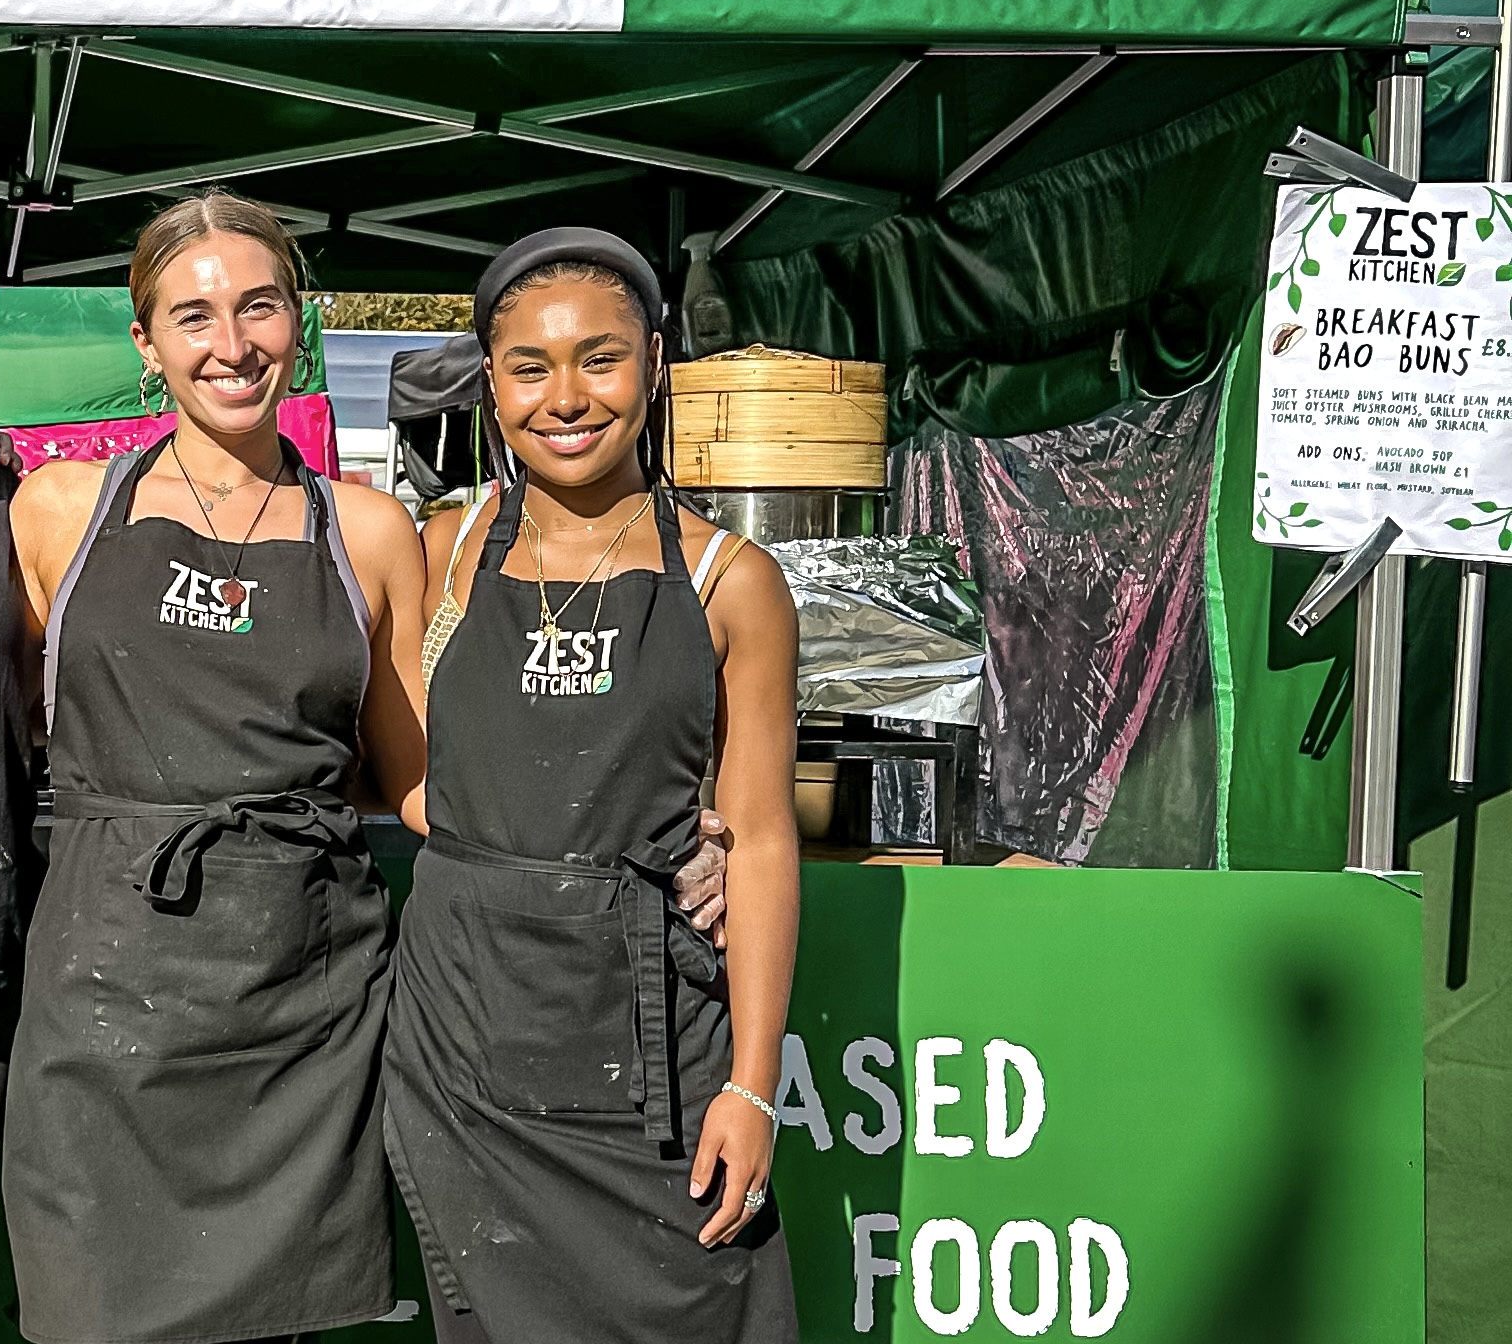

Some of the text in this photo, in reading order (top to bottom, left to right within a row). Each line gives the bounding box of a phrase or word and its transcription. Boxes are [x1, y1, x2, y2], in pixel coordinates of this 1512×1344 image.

[1353, 207, 1468, 260] ZEST
[1316, 307, 1481, 342] BREAKFAST
[1318, 341, 1472, 377] BAO BUNS
[1481, 338, 1512, 357] £8.
[1272, 388, 1512, 406] SOFT STEAMED BUNS WITH BLACK BEAN MA
[1305, 401, 1345, 413] OYSTER
[1430, 406, 1470, 418] GRILLED
[1368, 416, 1400, 428] ONION
[1408, 417, 1428, 429] AND
[1297, 444, 1322, 458] ADD
[1377, 446, 1424, 459] AVOCADO
[1375, 461, 1469, 478] HASH BROWN £1
[162, 560, 259, 617] ZEST
[523, 628, 620, 674] ZEST
[772, 1032, 1046, 1159] ASED
[853, 1212, 1131, 1339] FOOD
